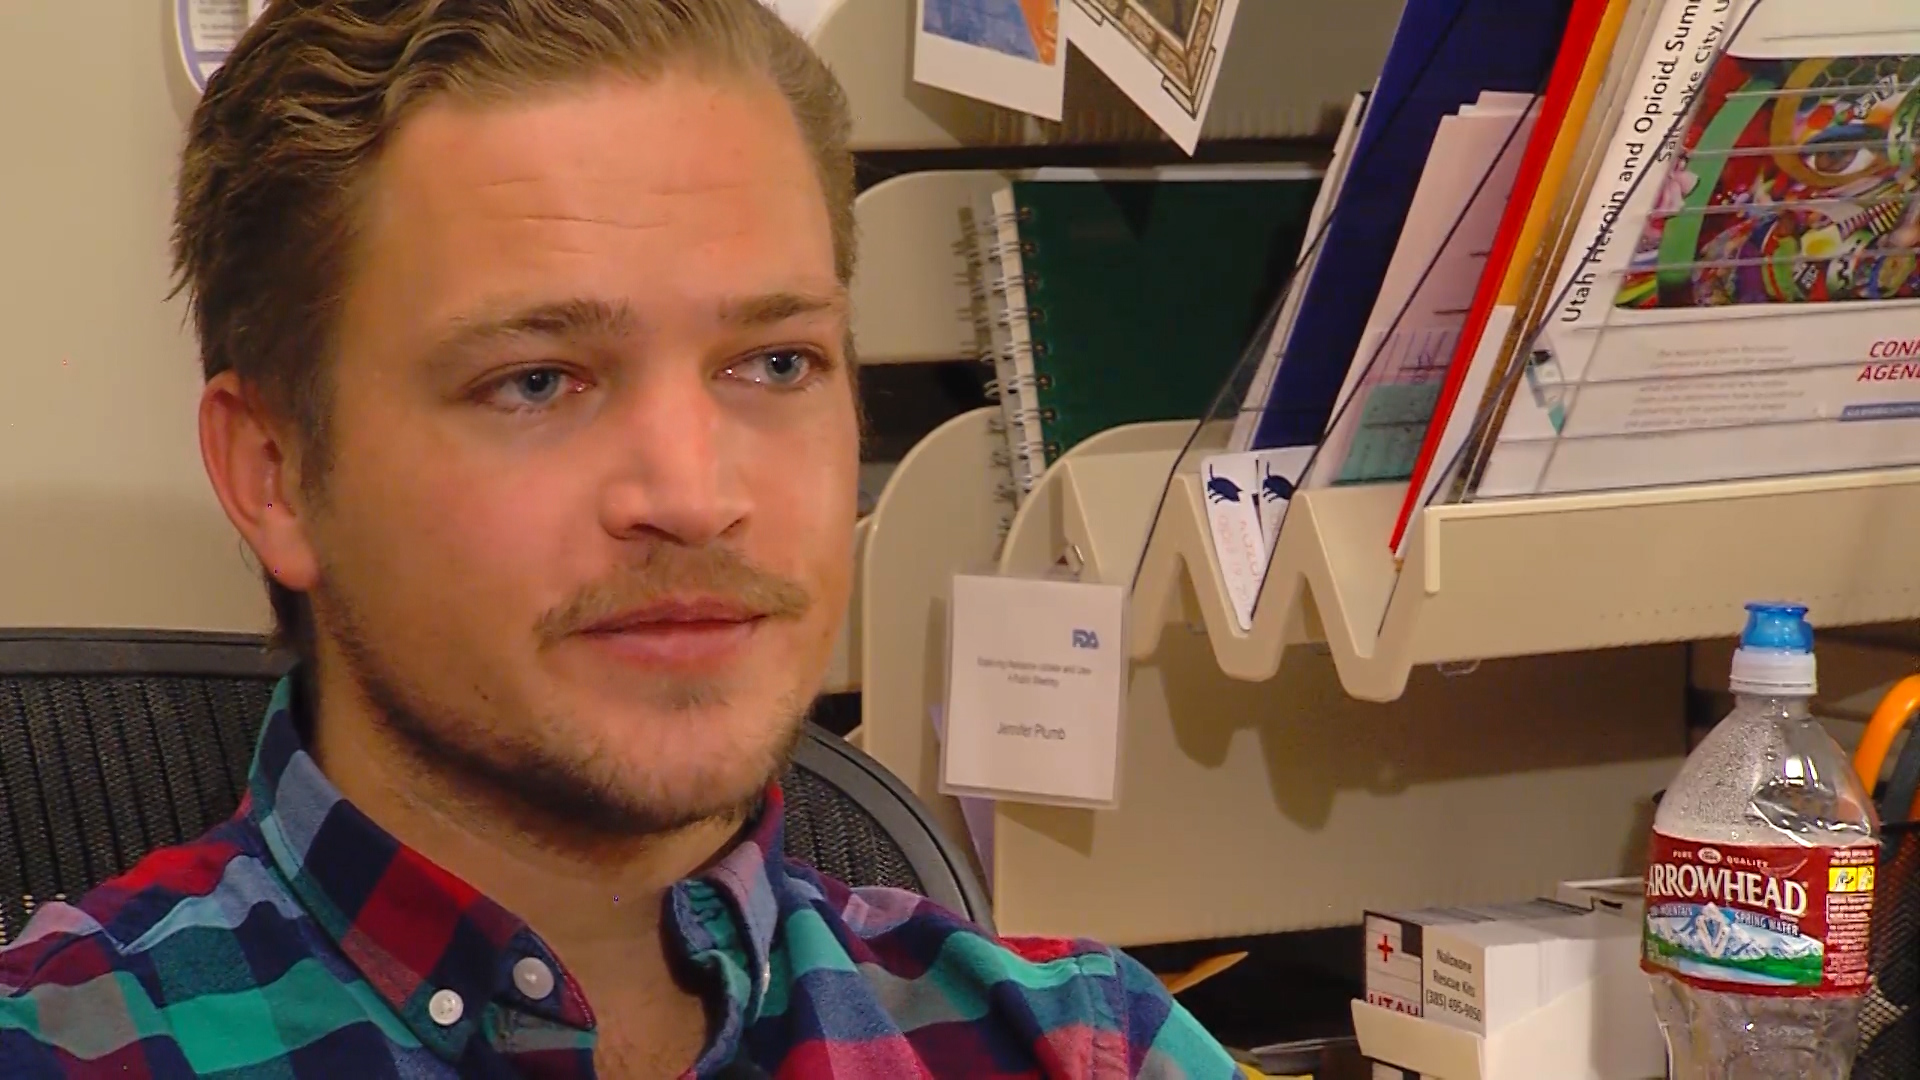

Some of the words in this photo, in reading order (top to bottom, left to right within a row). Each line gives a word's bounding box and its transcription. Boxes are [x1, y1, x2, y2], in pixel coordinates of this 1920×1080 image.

[1561, 273, 1597, 322] Utah
[1582, 190, 1626, 263] Heroin
[1618, 142, 1645, 184] and
[1634, 56, 1678, 133] Opioid
[1665, 0, 1701, 51] Sum
[1072, 628, 1099, 649] FDA
[1034, 723, 1066, 740] Plumb
[1646, 862, 1807, 918] ARROWHEAD
[1734, 911, 1767, 928] SPRING
[1768, 919, 1799, 936] WATER
[1436, 948, 1472, 974] Naloxone
[1433, 969, 1461, 991] Rescue
[1425, 989, 1447, 1011] (385)
